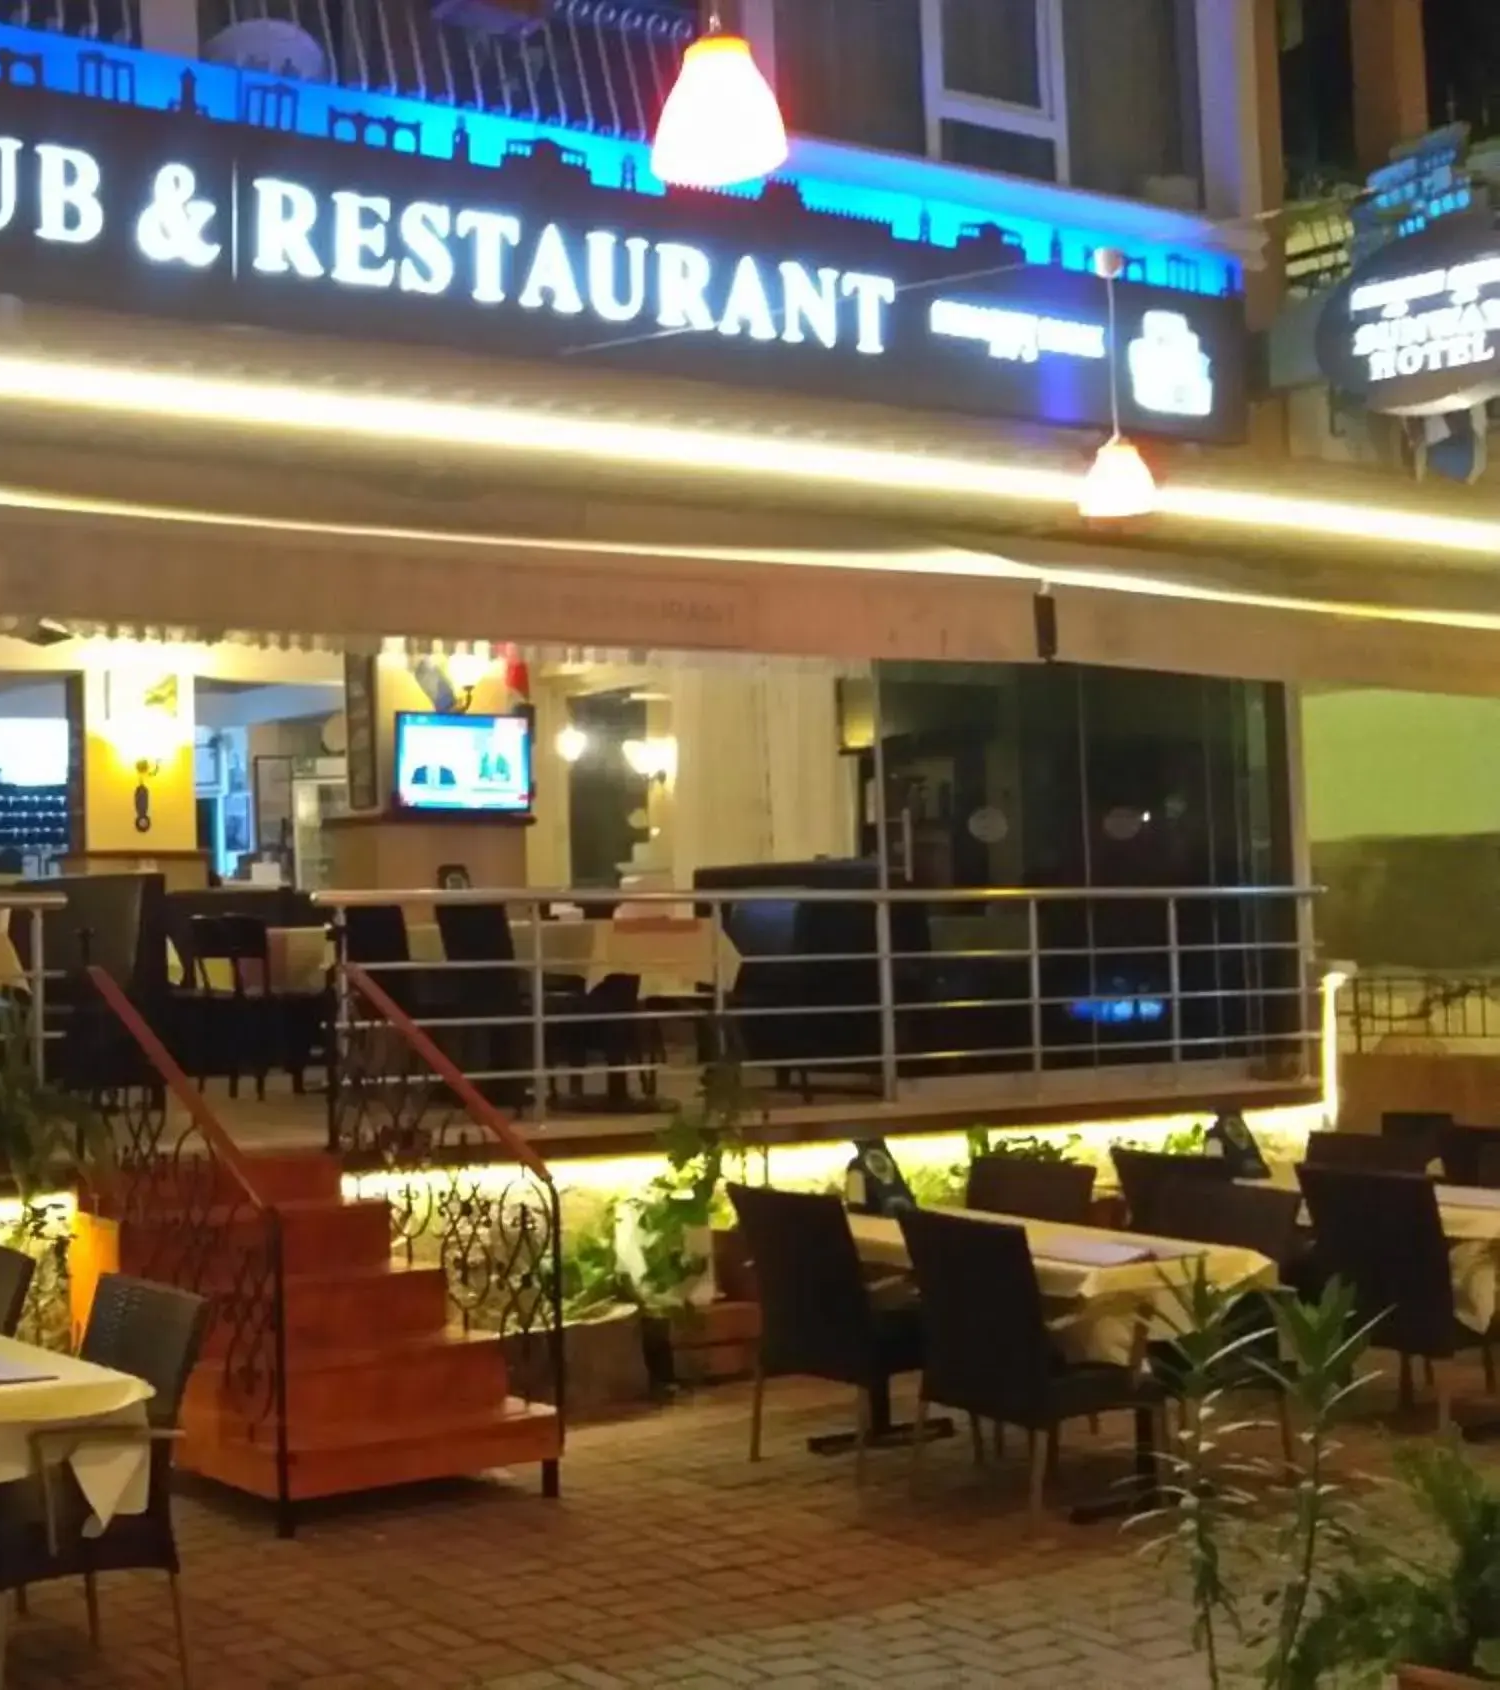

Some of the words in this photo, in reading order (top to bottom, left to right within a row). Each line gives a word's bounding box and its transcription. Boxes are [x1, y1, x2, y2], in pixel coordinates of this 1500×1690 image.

[135, 162, 222, 268] &
[251, 177, 897, 354] RESTAURANT
[1369, 331, 1495, 381] HOTEL
